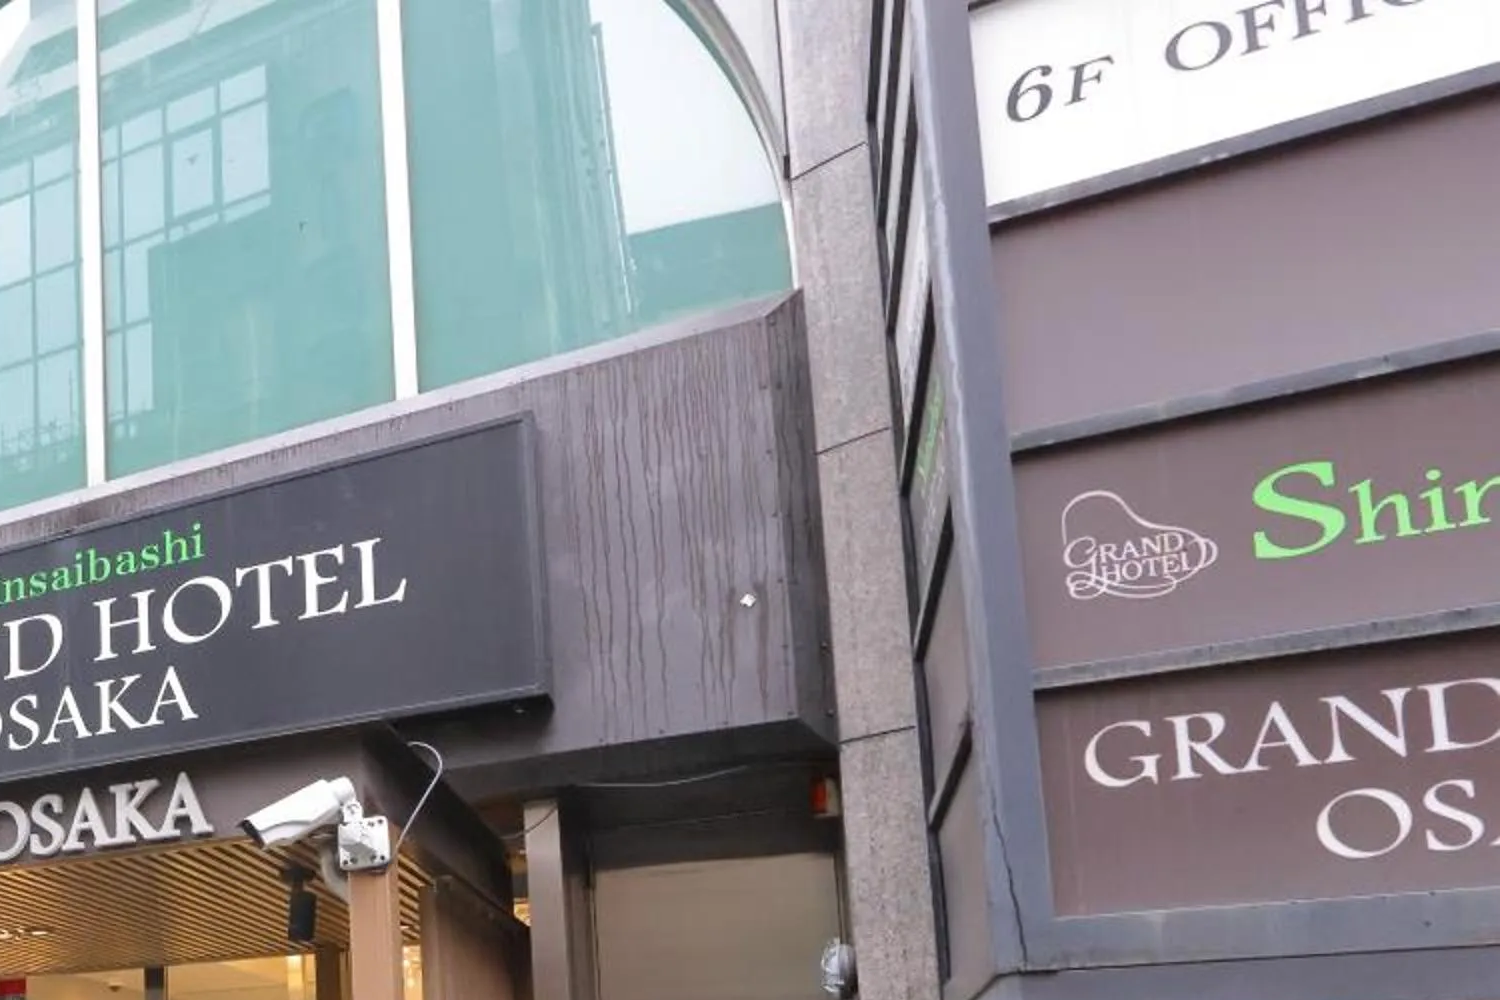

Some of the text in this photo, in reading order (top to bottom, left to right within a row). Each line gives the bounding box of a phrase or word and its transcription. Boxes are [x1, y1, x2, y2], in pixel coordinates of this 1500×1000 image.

[1006, 0, 1425, 123] 6F OFF
[93, 536, 408, 662] HOTEL
[1063, 531, 1185, 572] GRAND
[1101, 552, 1192, 584] HOTEL
[1084, 677, 1500, 788] GRAND
[1315, 779, 1500, 859] OS
